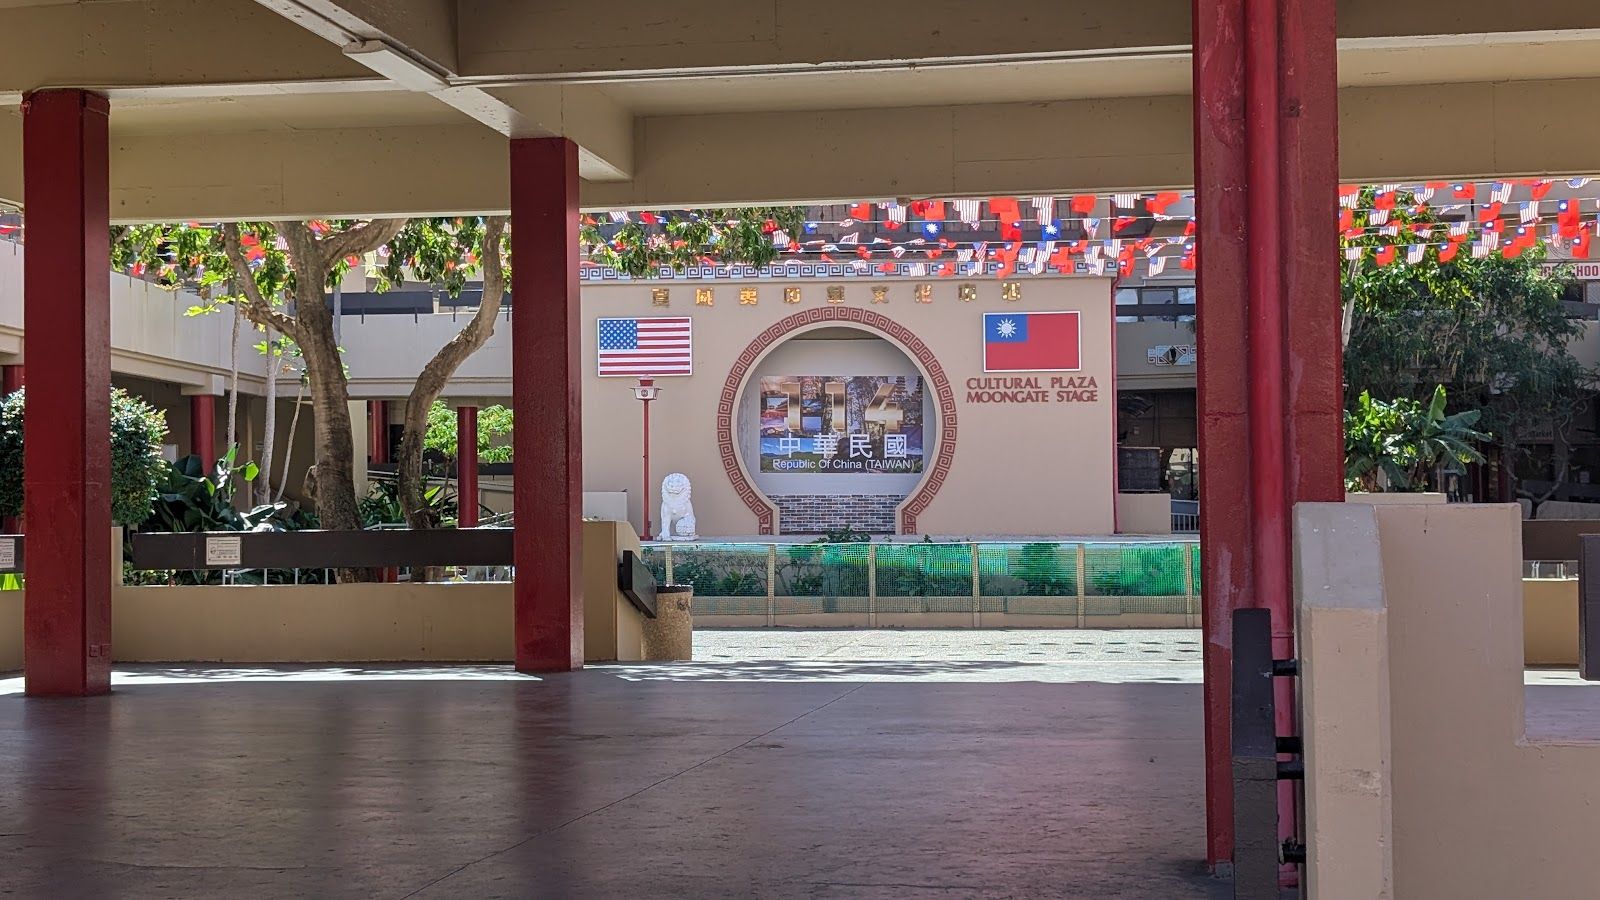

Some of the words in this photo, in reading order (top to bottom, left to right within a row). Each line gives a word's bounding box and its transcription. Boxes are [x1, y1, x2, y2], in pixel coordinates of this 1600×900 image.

[966, 377, 1042, 390] CULTURAL
[1050, 376, 1098, 389] PLAZA
[966, 391, 1049, 403] MOONGATE
[1056, 390, 1098, 402] STAGE
[780, 382, 904, 431] 114
[779, 433, 907, 459] 中華民國
[772, 459, 816, 470] Republic
[818, 459, 832, 469] Of
[833, 459, 862, 469] China
[865, 459, 915, 470] (TAIWAN)
